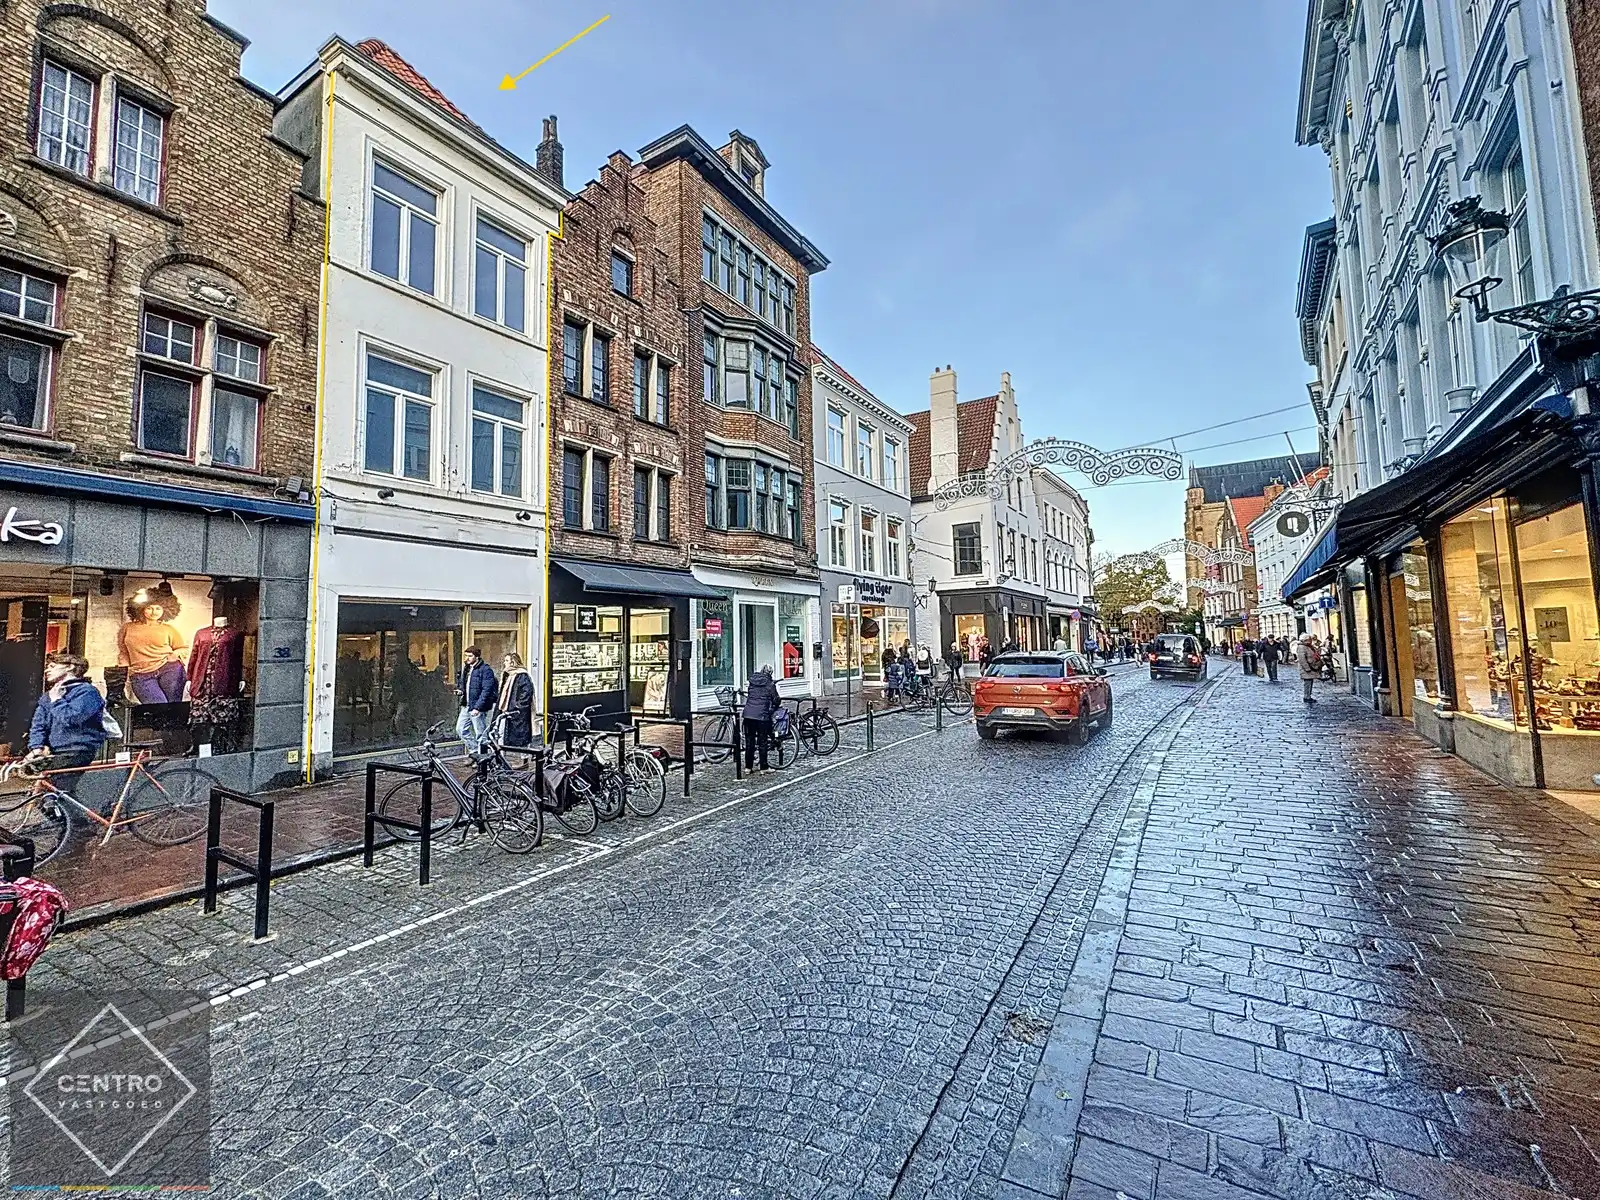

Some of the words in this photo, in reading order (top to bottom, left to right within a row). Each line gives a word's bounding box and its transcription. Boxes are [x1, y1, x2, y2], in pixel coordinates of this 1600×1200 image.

[847, 586, 853, 595] P
[853, 577, 875, 595] flying
[875, 581, 893, 597] tiger
[701, 600, 729, 616] Queen
[273, 647, 291, 658] 38
[784, 657, 790, 665] TE
[790, 657, 804, 665] HUUR
